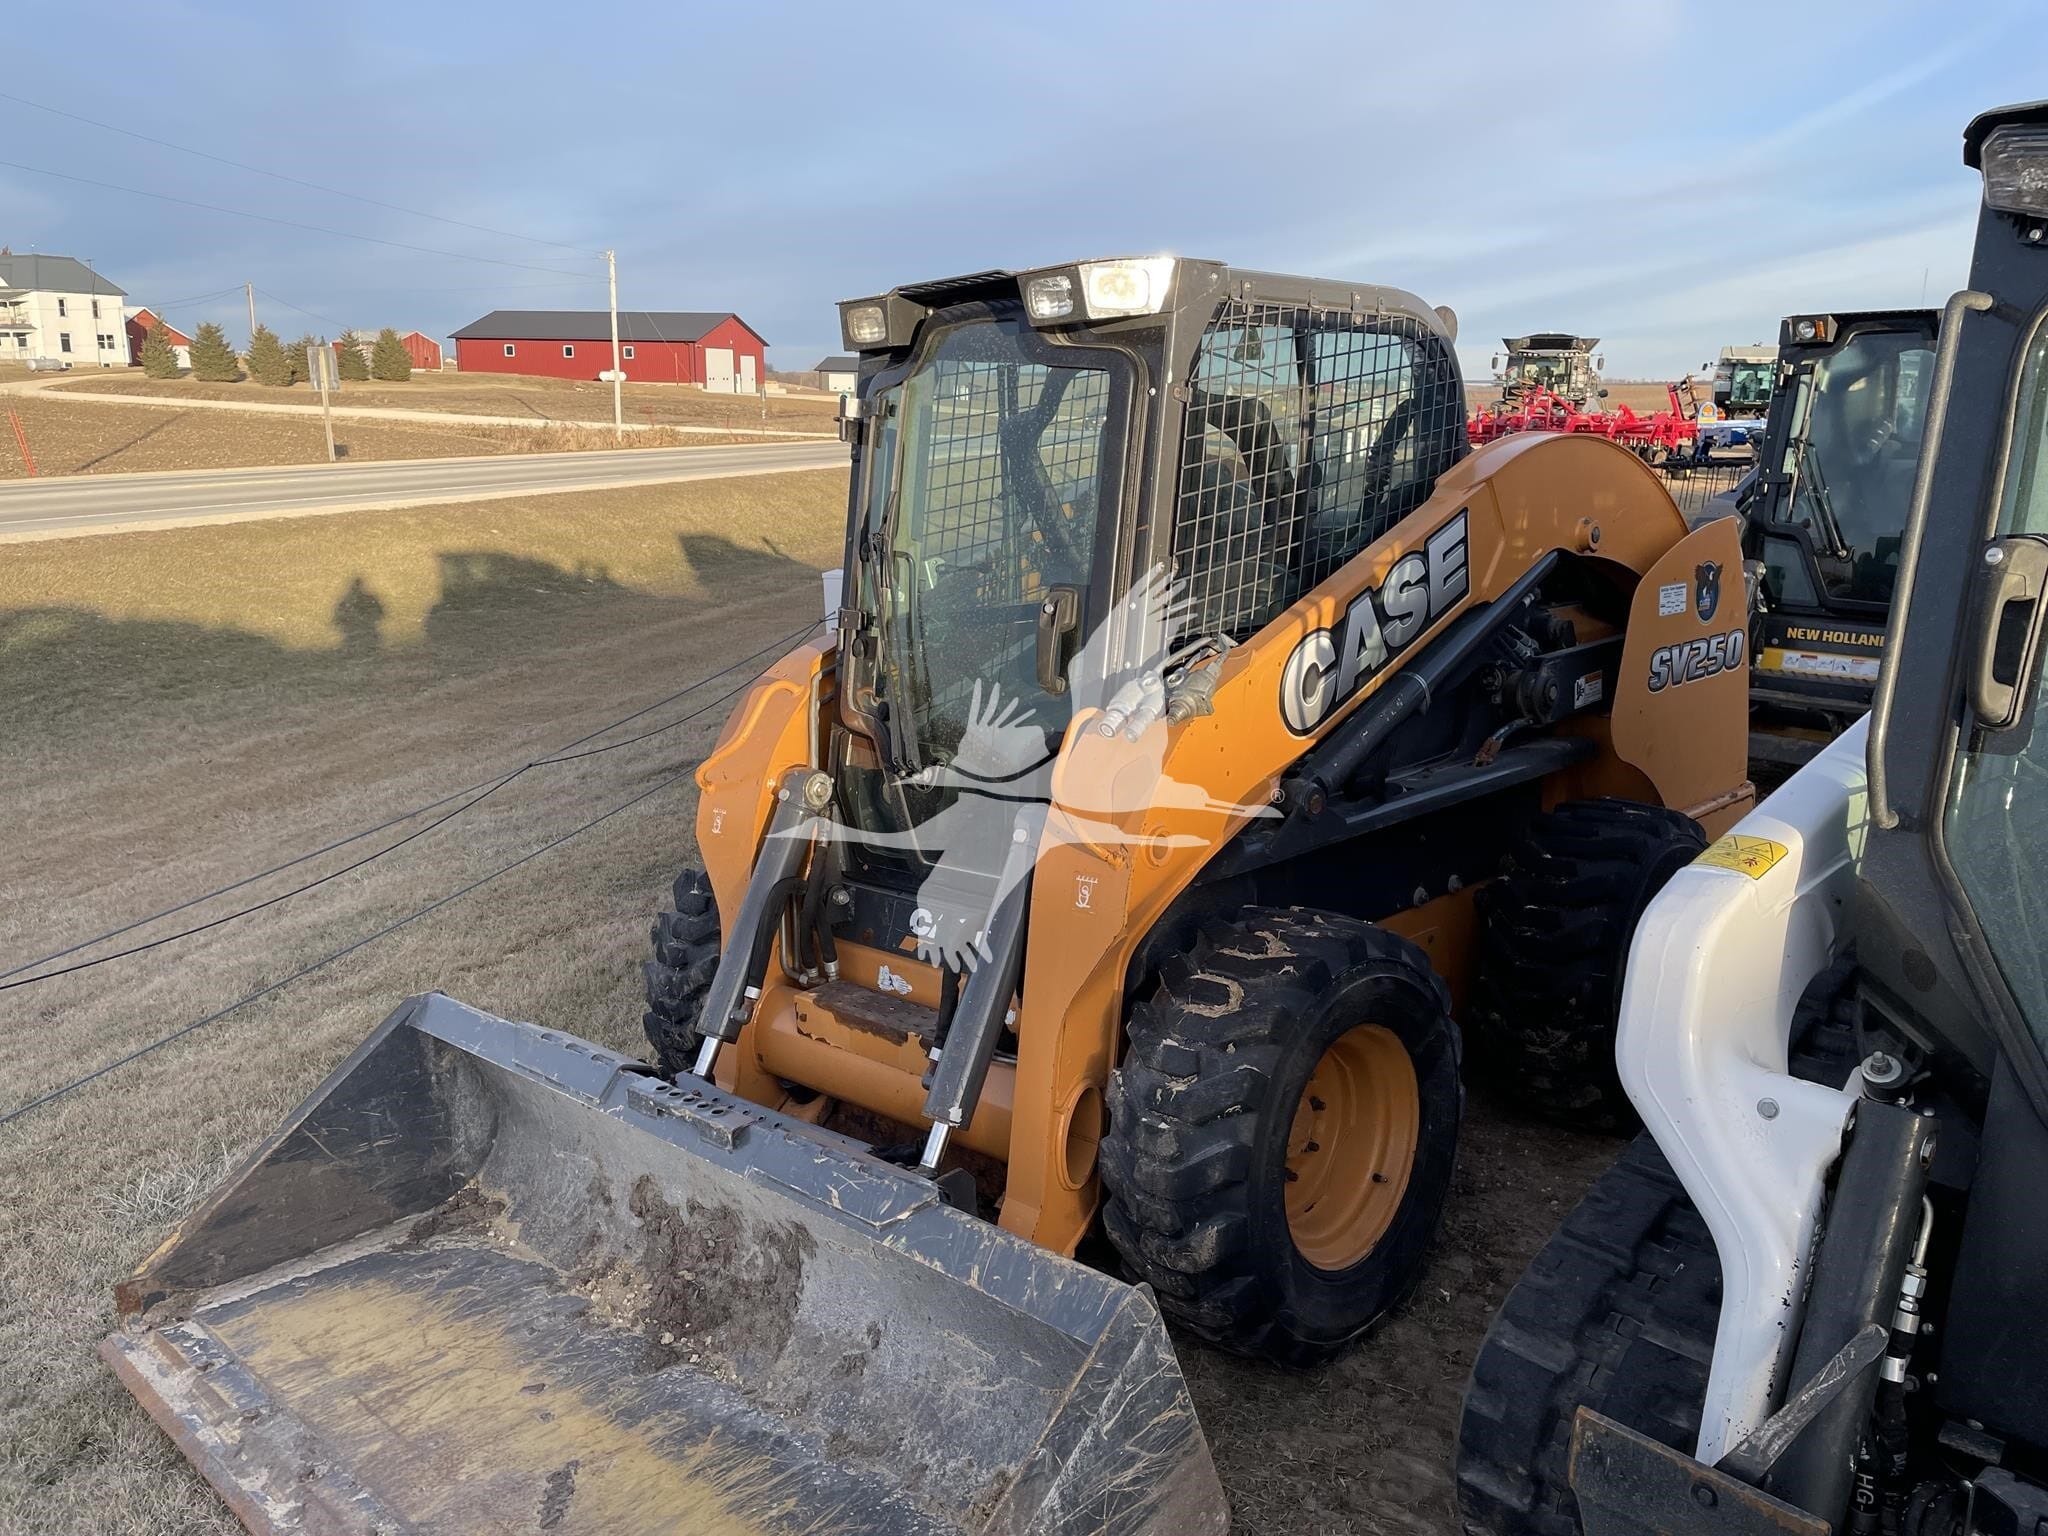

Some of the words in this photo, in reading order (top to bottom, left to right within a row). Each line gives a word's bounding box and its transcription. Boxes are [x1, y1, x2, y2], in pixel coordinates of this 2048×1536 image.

[1281, 509, 1470, 734] CASE
[1786, 626, 1820, 641] NEW
[1648, 629, 1745, 693] SV250
